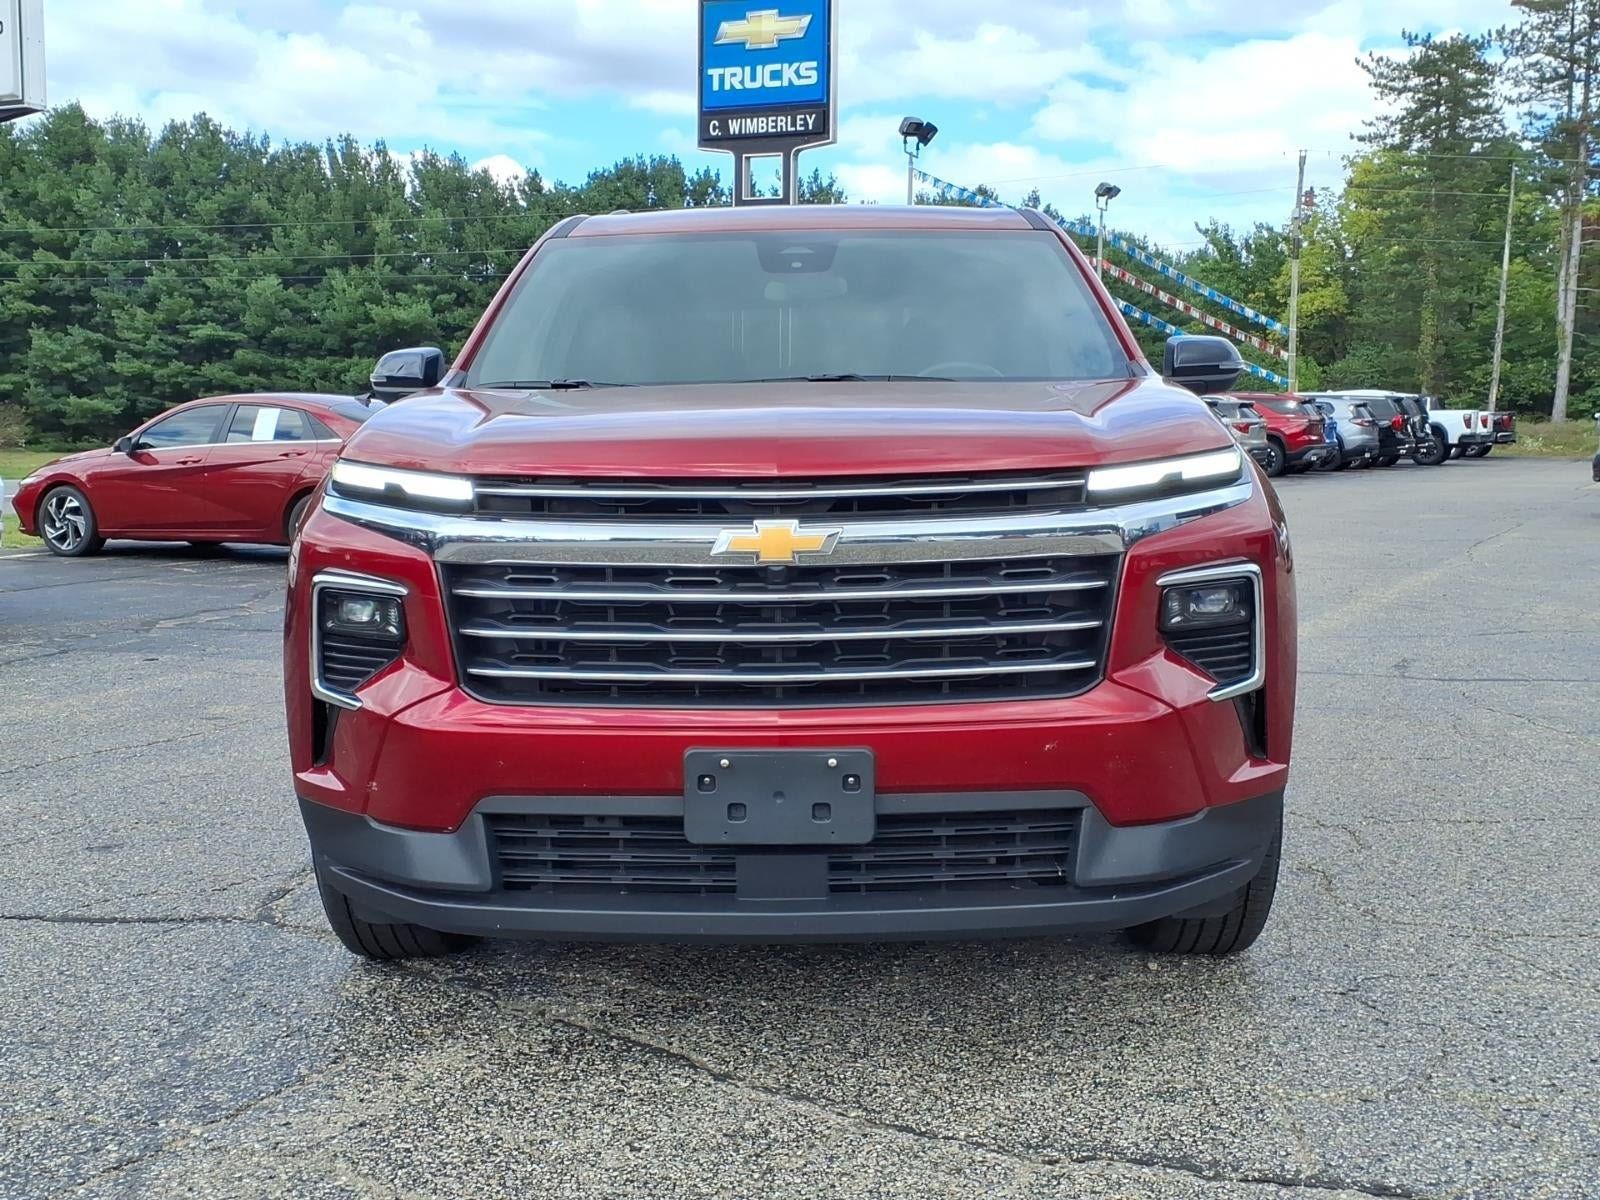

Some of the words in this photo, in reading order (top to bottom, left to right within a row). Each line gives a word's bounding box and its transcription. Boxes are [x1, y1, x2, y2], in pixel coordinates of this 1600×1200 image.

[707, 61, 818, 92] TRUCKS
[709, 120, 722, 136] C.
[728, 114, 816, 135] WIMBERLEY
